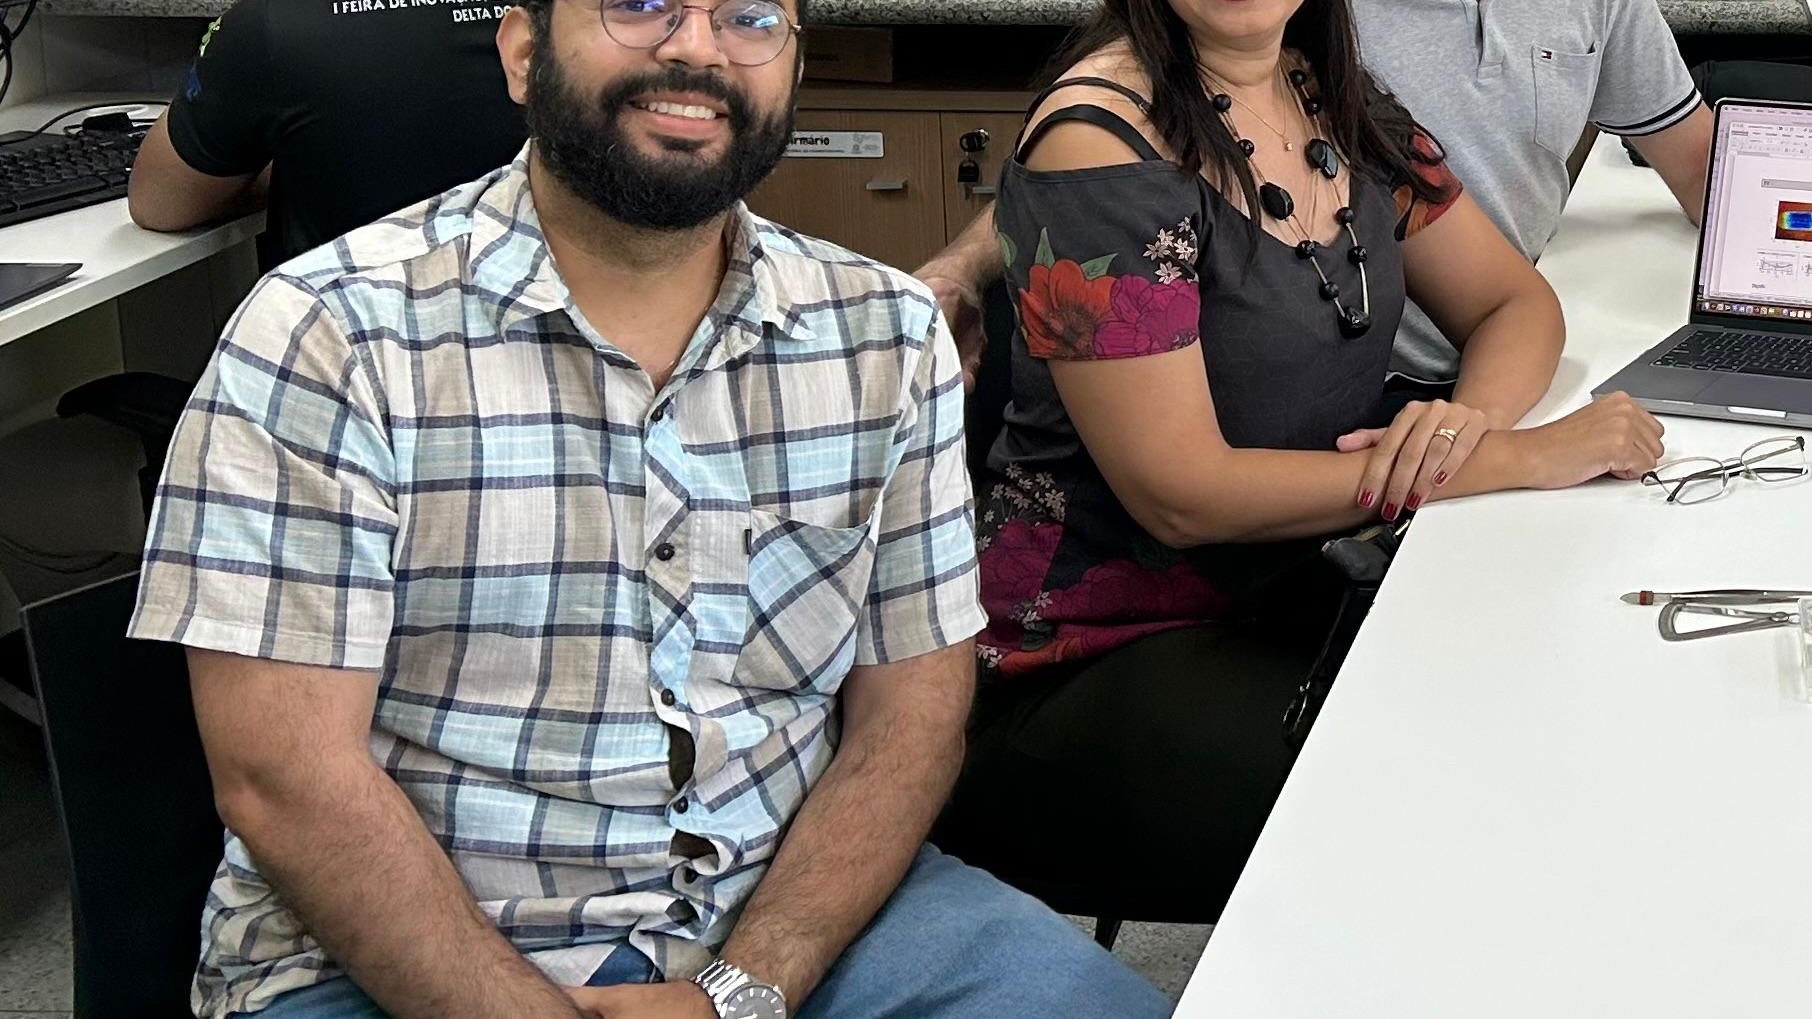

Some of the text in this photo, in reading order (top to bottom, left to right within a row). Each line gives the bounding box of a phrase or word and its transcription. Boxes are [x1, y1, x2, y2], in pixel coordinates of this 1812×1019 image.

[332, 1, 339, 15] I
[453, 7, 492, 23] DELTA
[791, 133, 831, 146] rmário
